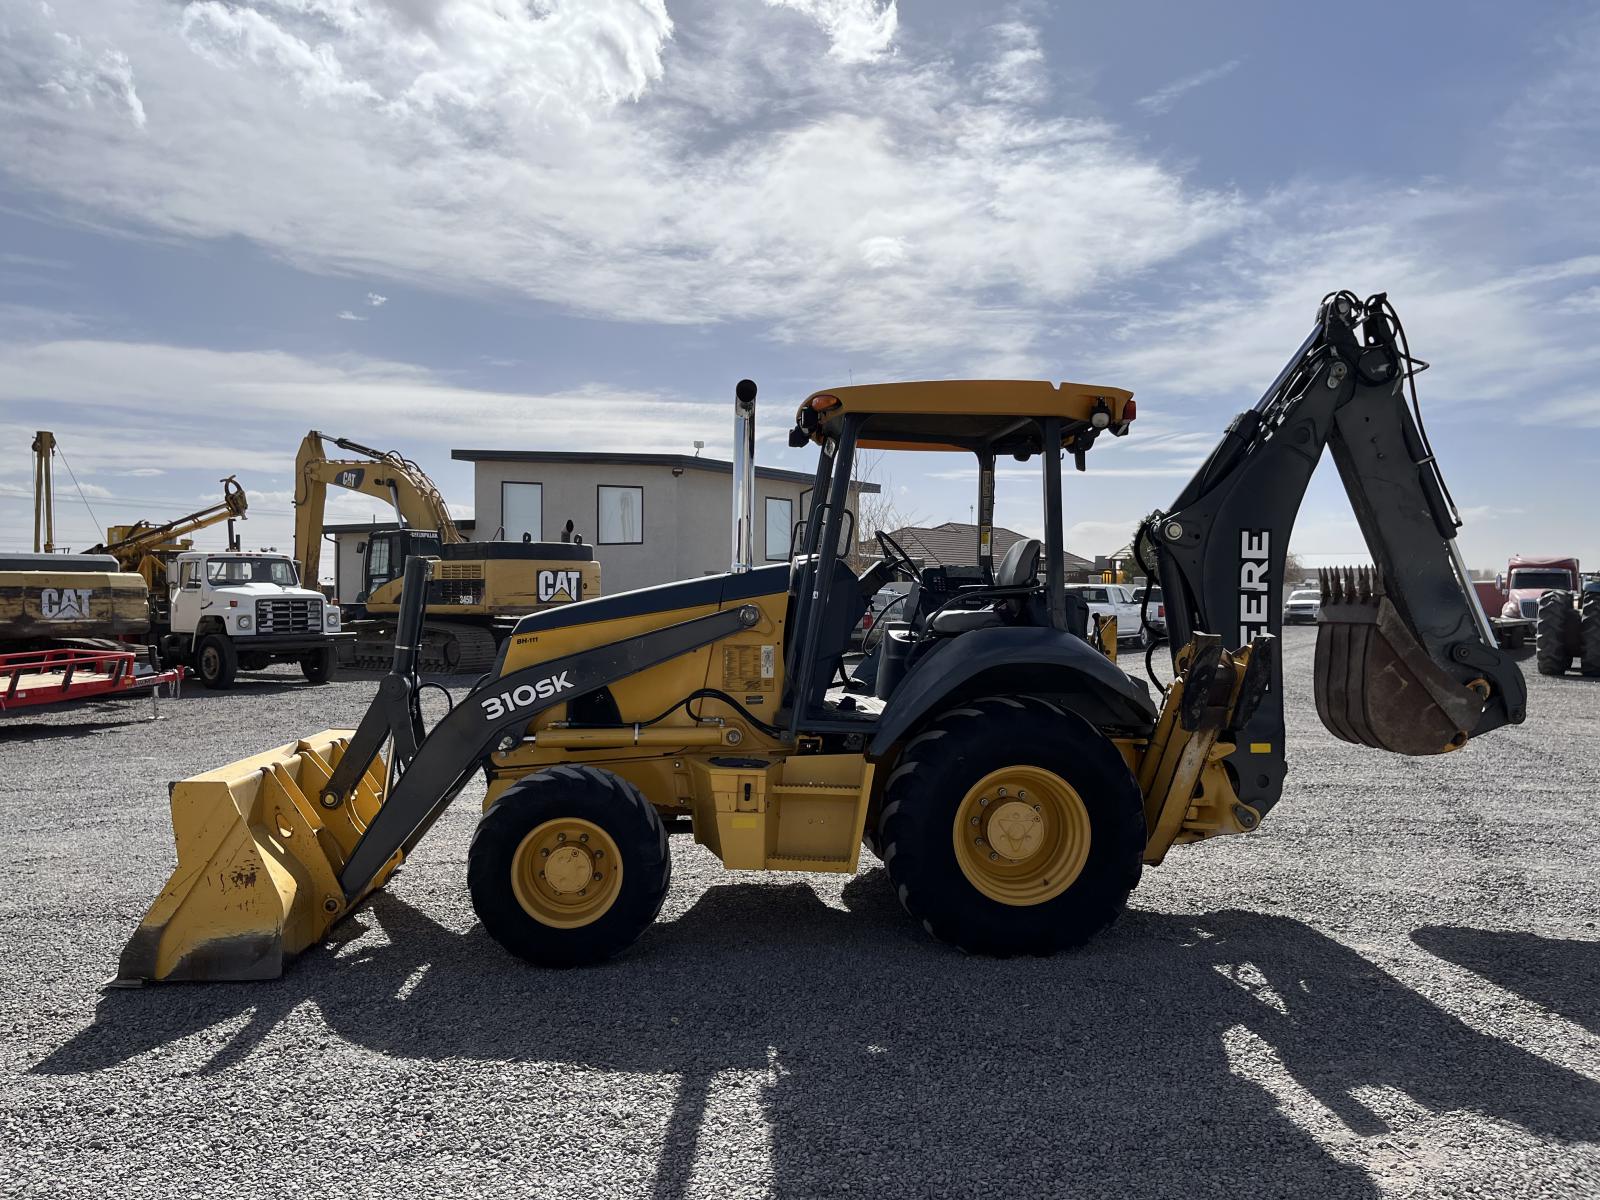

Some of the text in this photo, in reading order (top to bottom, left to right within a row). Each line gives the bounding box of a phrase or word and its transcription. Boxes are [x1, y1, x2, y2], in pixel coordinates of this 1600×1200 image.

[343, 471, 356, 487] CAT
[539, 570, 580, 602] CAT
[41, 588, 93, 619] CAT
[1240, 531, 1269, 690] EERE
[481, 670, 575, 720] 310SK
